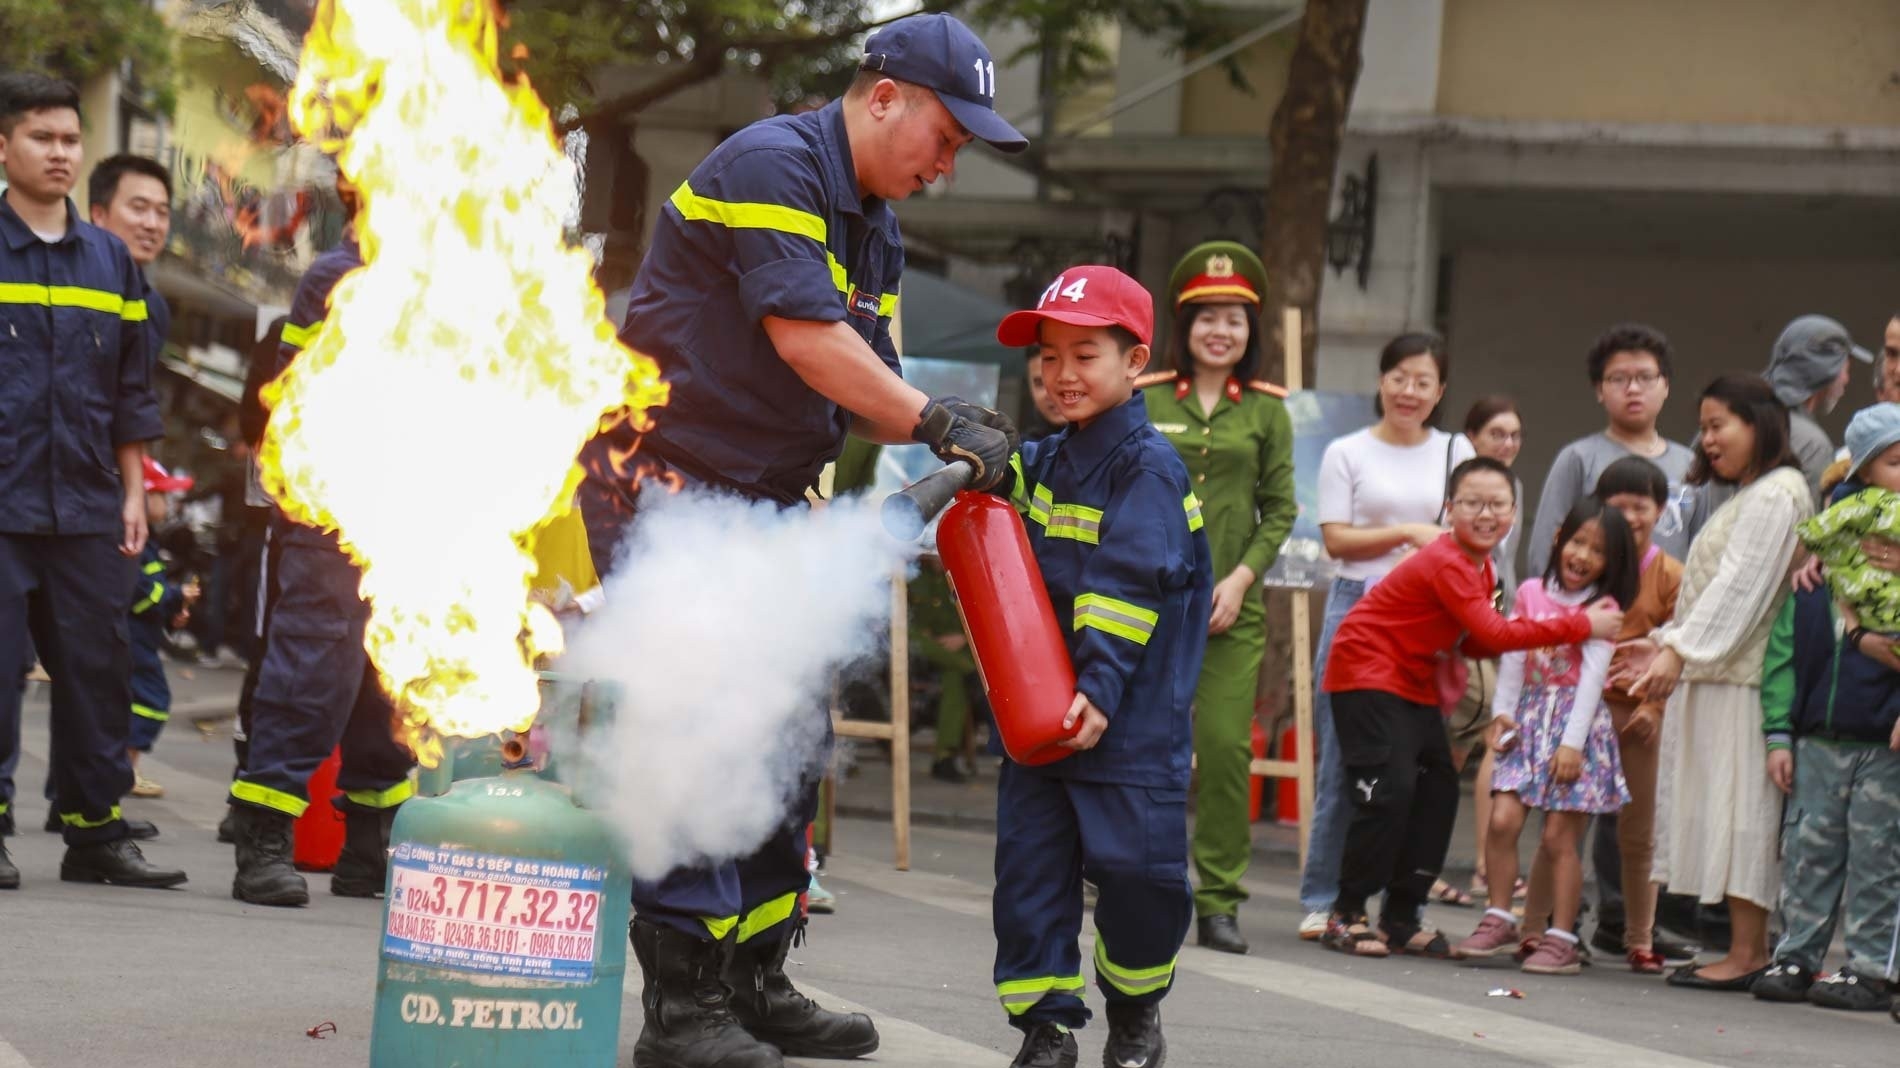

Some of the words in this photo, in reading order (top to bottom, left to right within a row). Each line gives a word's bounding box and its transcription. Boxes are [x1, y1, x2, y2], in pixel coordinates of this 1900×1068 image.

[411, 847, 435, 862] CÔNG
[437, 852, 450, 864] TY
[452, 855, 474, 868] GAS
[515, 863, 538, 875] GAS
[541, 864, 580, 879] HOÀNG
[444, 922, 519, 954] 02436.36.9191
[529, 932, 592, 960] 0989.920.828
[400, 994, 446, 1026] CD.
[450, 997, 582, 1030] PETROL
